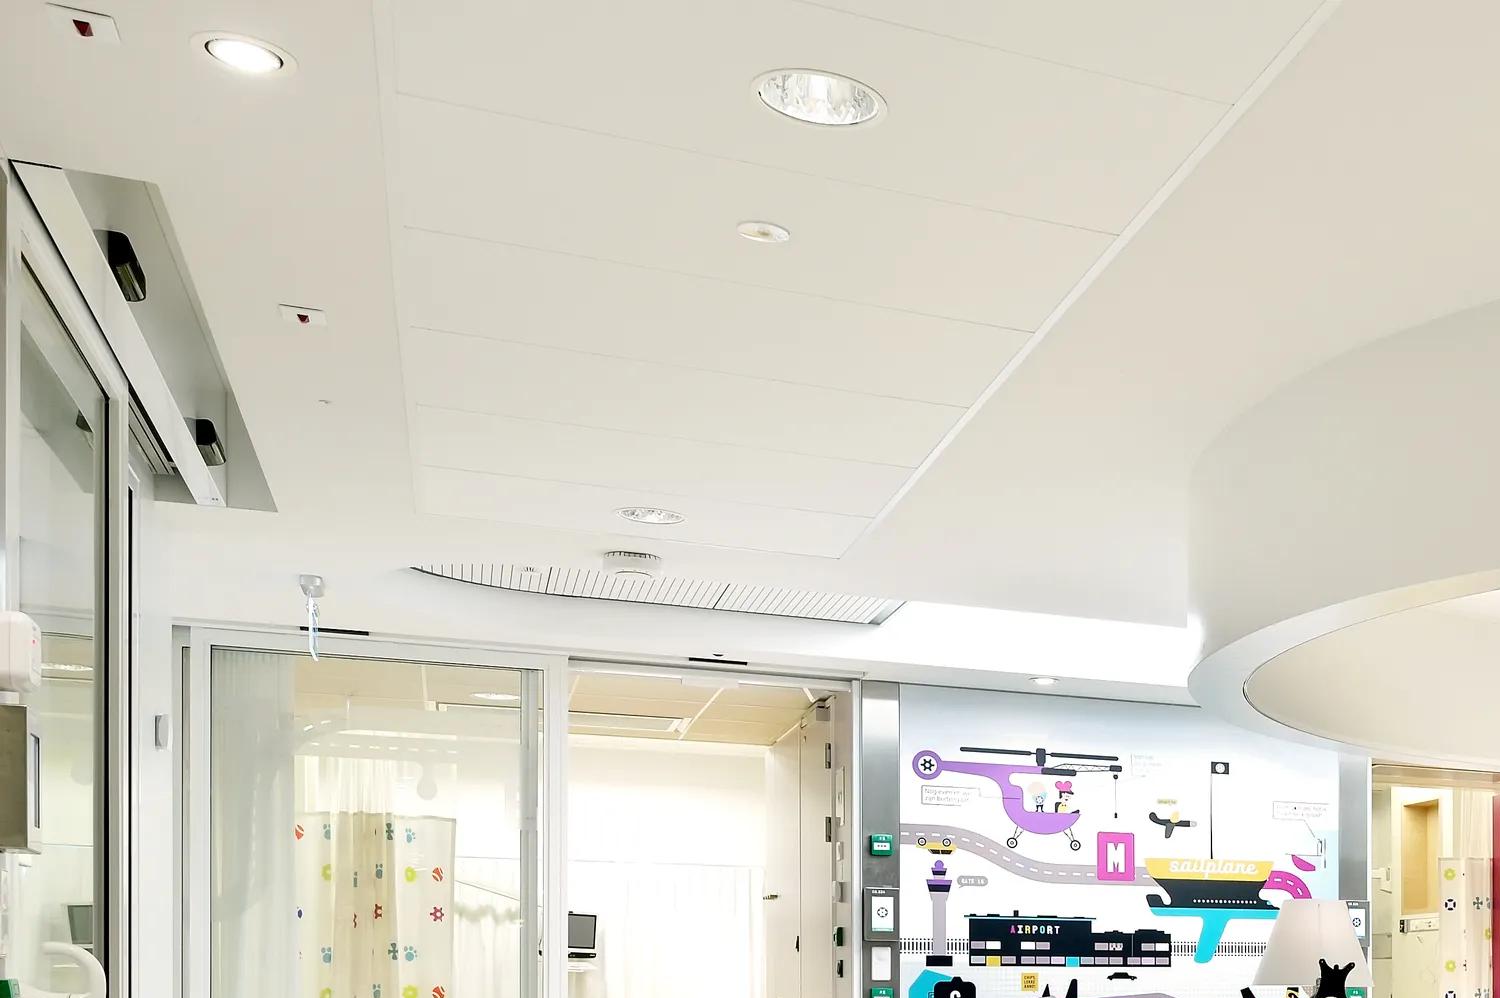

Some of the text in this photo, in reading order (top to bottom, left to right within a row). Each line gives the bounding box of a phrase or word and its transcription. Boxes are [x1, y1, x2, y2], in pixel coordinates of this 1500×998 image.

[1107, 842, 1126, 873] M
[1169, 860, 1258, 880] sailplane
[1010, 924, 1060, 935] AIRPORT
